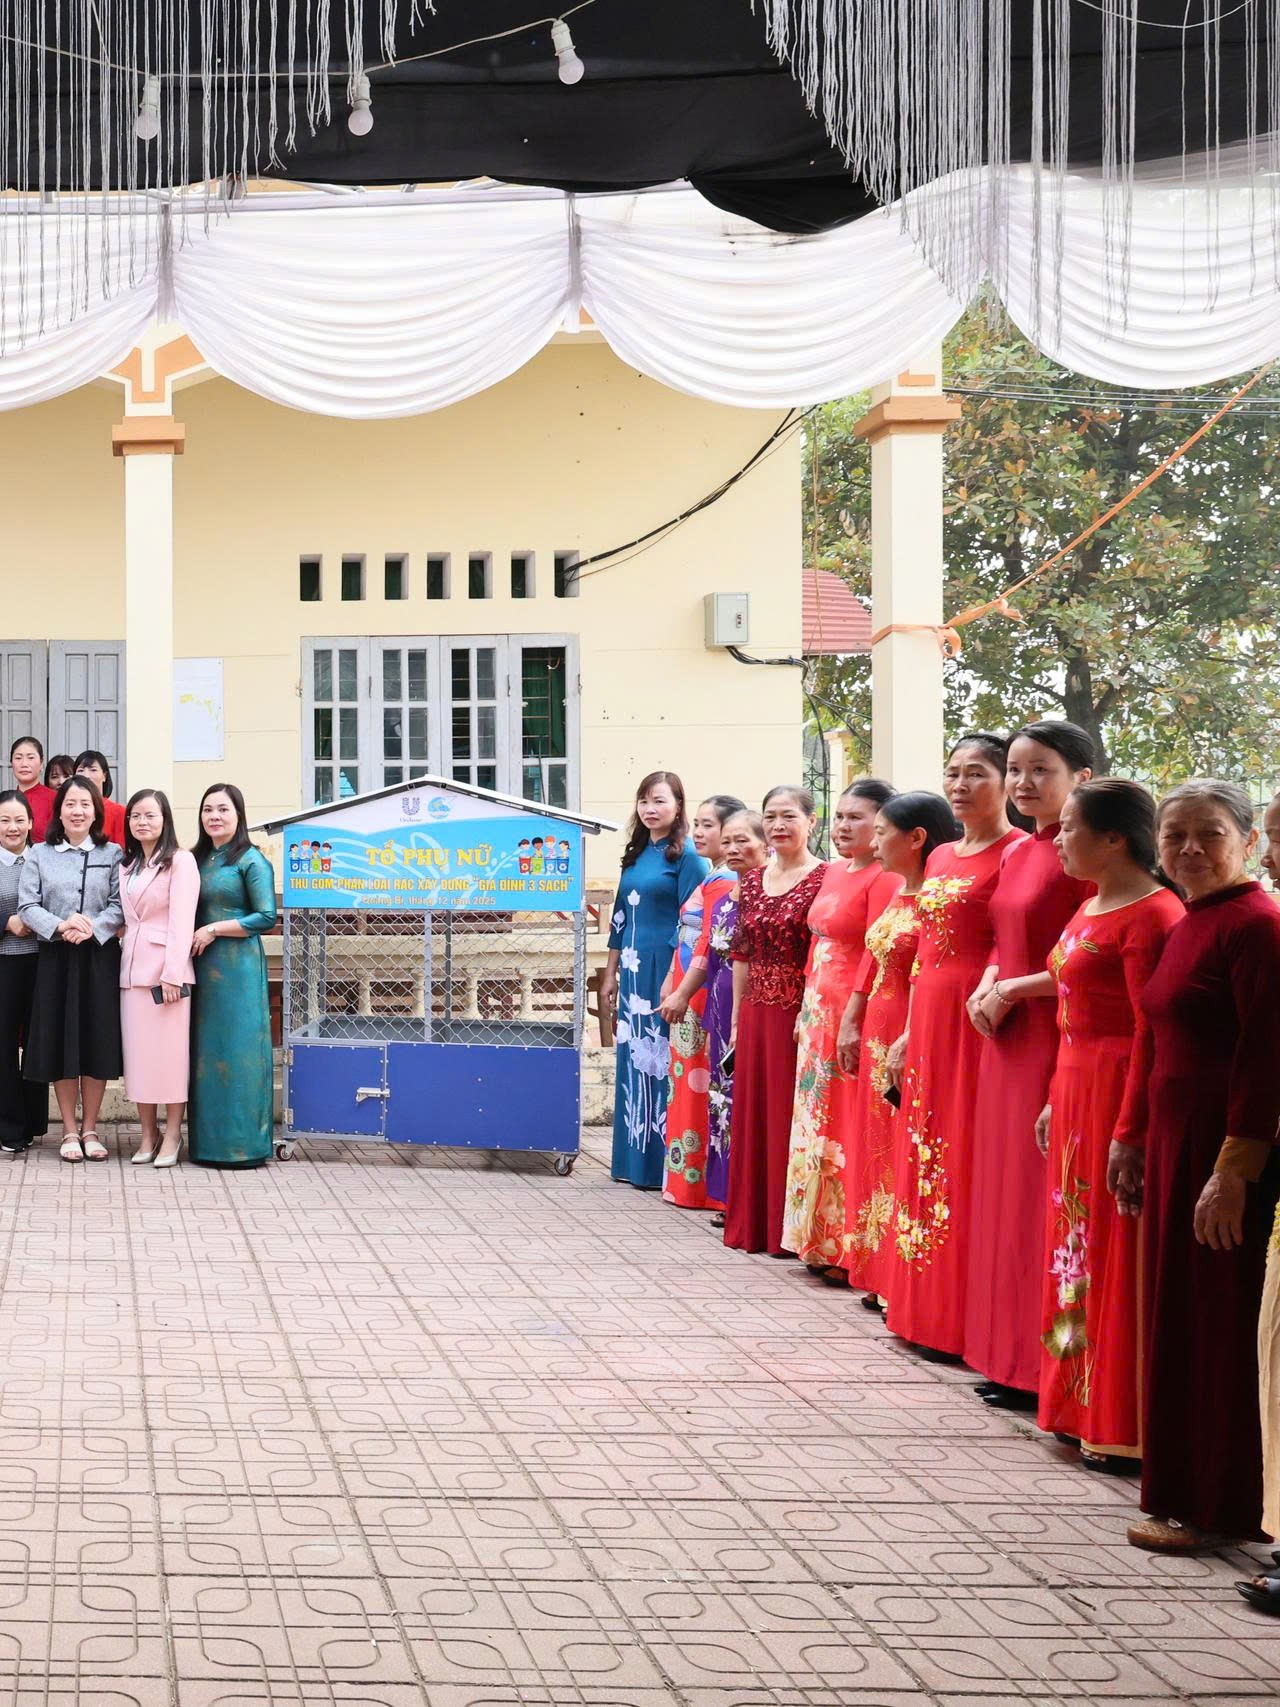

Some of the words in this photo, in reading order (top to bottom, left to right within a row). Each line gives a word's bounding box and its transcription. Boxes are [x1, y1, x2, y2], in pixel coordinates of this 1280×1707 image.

[366, 839, 396, 866] TỔ
[402, 847, 450, 871] PHỤ
[456, 843, 493, 866] NỮ
[290, 877, 308, 889] THU
[312, 878, 334, 889] GOM
[337, 876, 365, 890] PHÂN
[417, 876, 438, 890] XÂY
[500, 876, 526, 891] ĐÌNH
[528, 879, 536, 891] 3
[437, 896, 448, 905] 12
